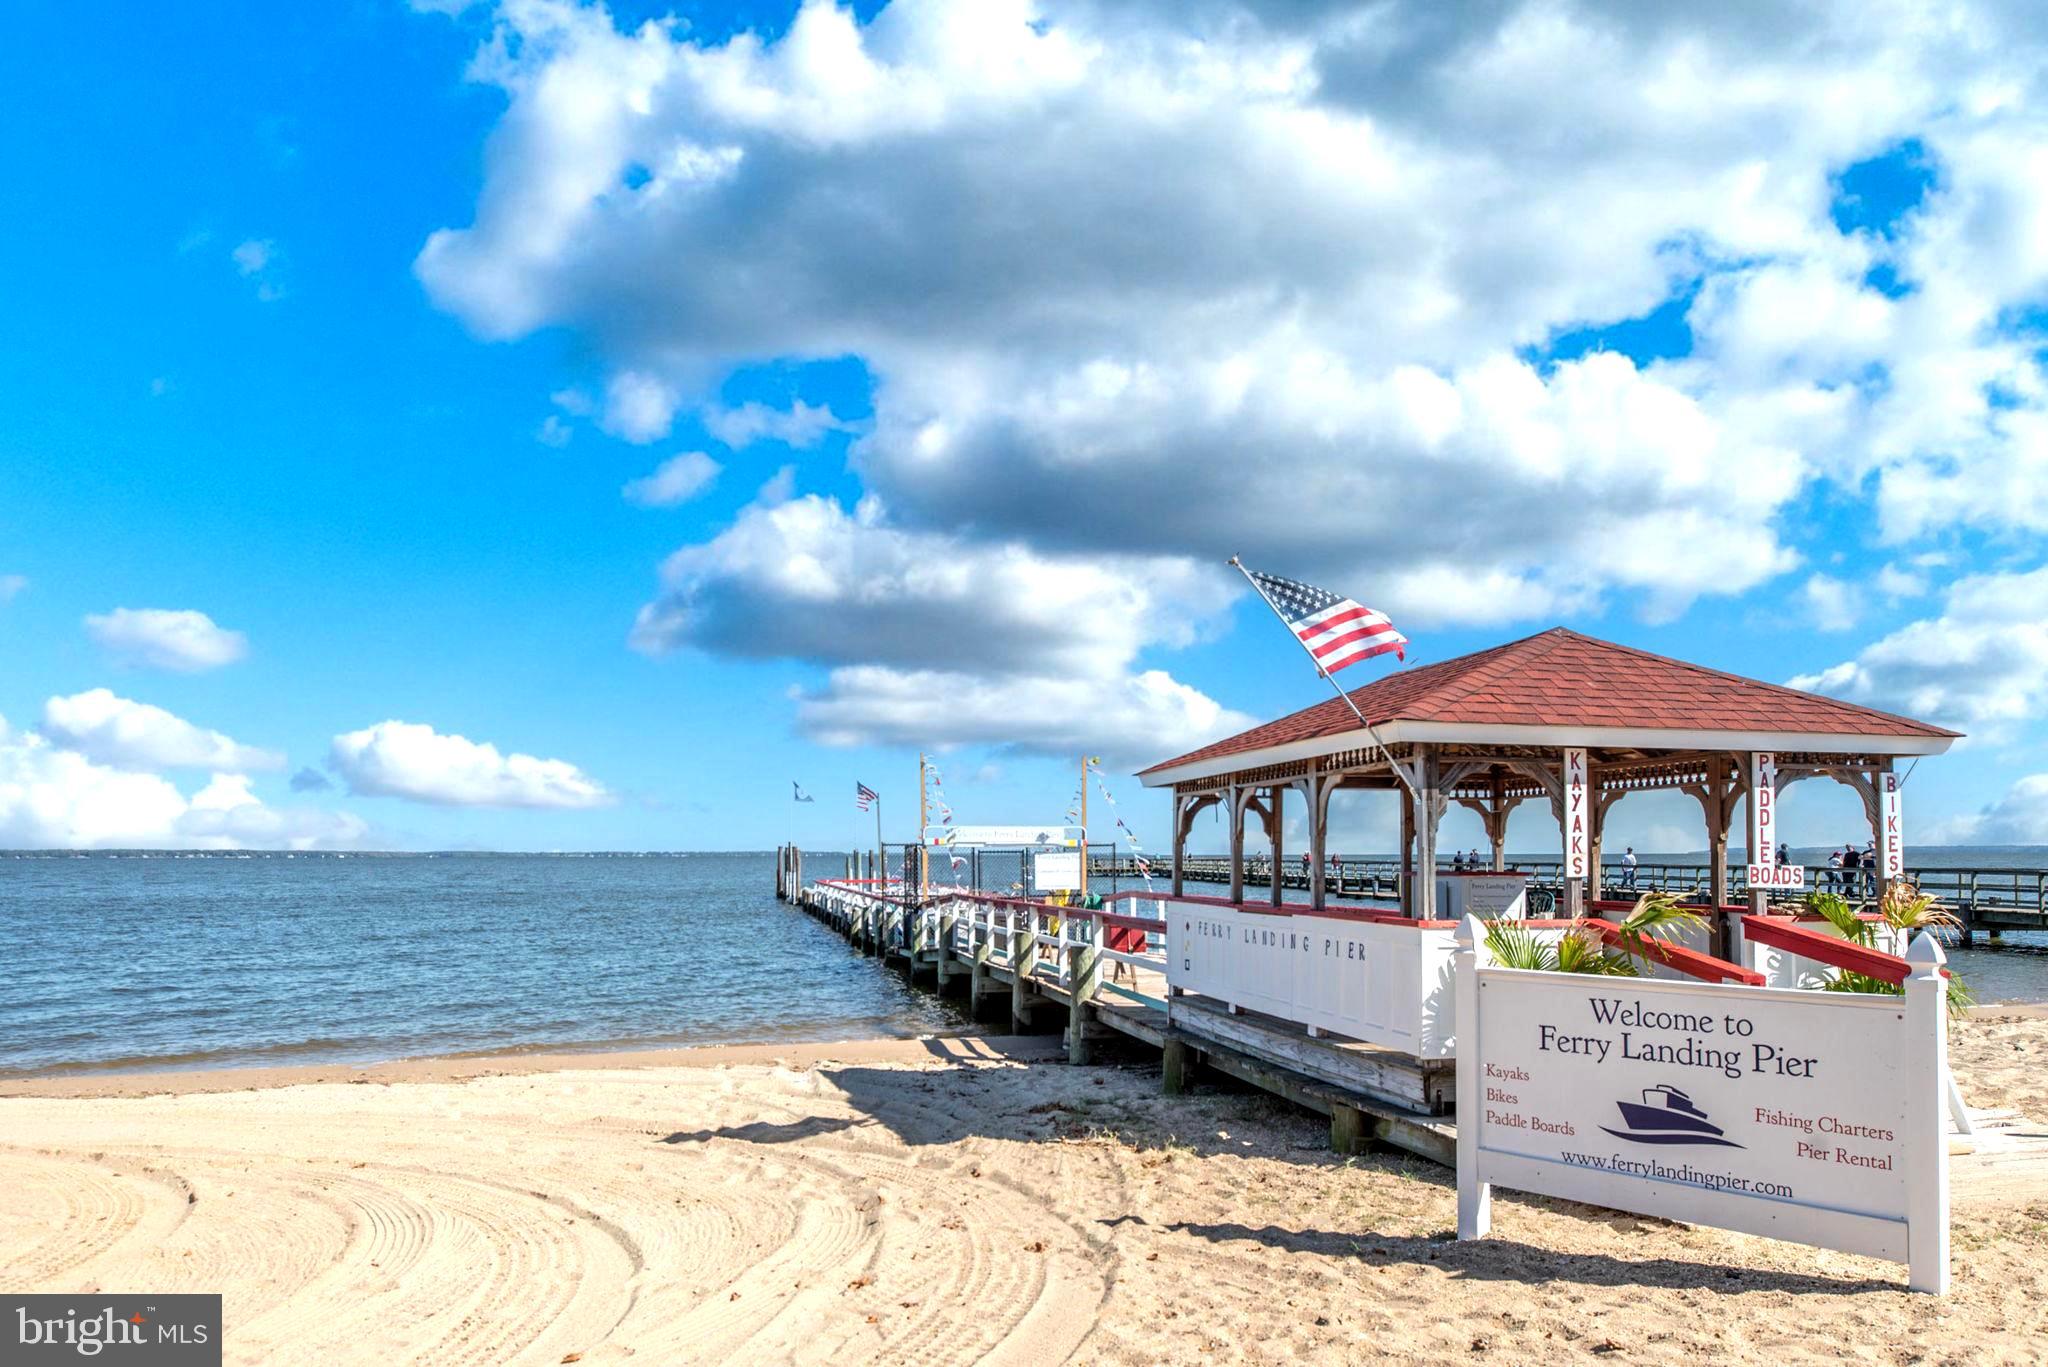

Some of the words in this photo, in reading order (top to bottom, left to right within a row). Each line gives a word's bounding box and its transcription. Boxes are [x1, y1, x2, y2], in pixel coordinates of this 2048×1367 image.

[1569, 751, 1583, 874] KAYAKS
[1758, 754, 1770, 864] PADDLE
[1886, 775, 1899, 872] BIKES
[1750, 867, 1802, 884] BOADS
[1197, 920, 1231, 940] FERRY
[1244, 928, 1309, 952] LANDING
[1325, 939, 1366, 961] PIER
[1588, 998, 1714, 1033] Welcome
[1723, 1014, 1754, 1037] to
[1538, 1024, 1612, 1063] Ferry
[1620, 1032, 1742, 1079] Landing
[1751, 1043, 1818, 1079] Pier
[1486, 1063, 1530, 1082] Kayaks
[1486, 1087, 1518, 1105] Bikes
[1486, 1110, 1527, 1129] Paddle
[1531, 1116, 1575, 1136] Boards
[1755, 1107, 1813, 1134] Fishing
[1818, 1116, 1894, 1141] Charters
[1561, 1151, 1793, 1198] www.ferrylandingpier.com
[1796, 1141, 1830, 1161] Pier
[1835, 1147, 1893, 1171] Rental
